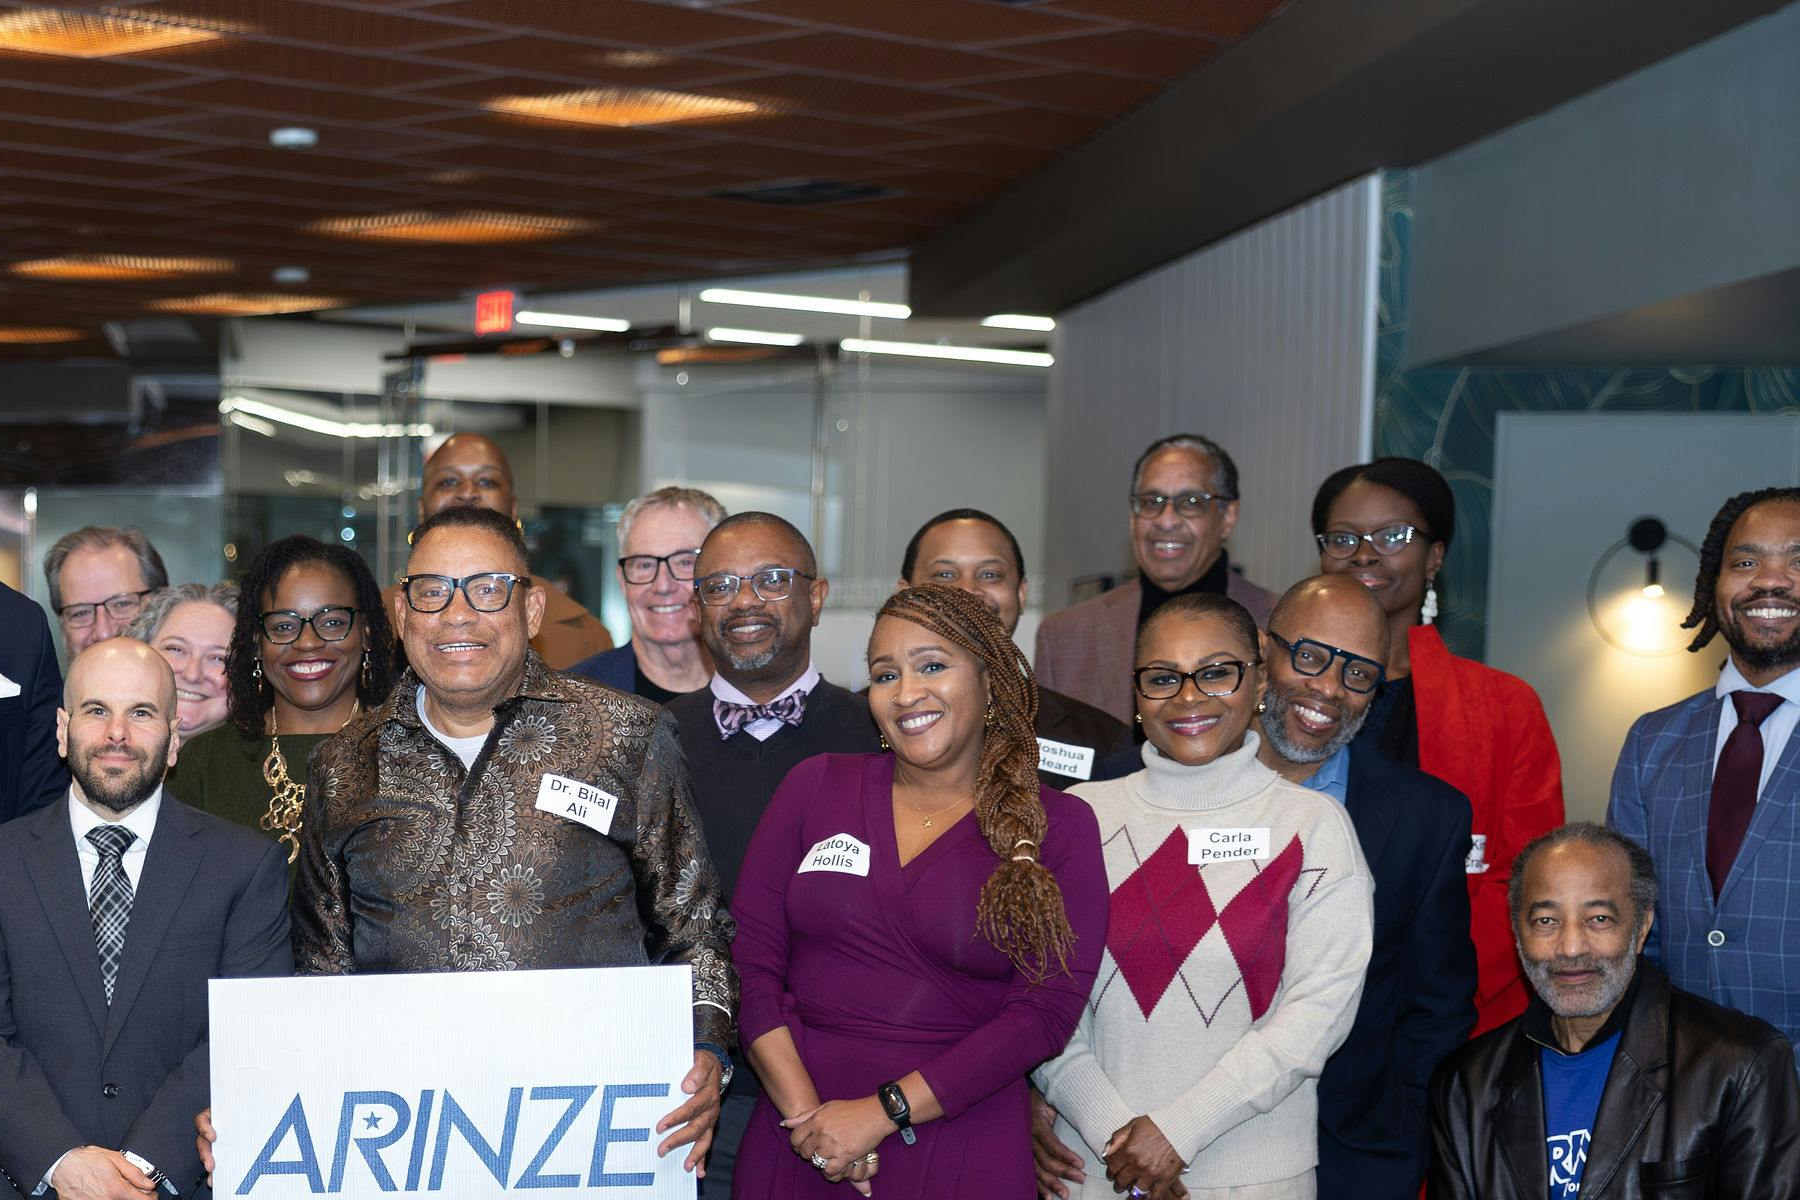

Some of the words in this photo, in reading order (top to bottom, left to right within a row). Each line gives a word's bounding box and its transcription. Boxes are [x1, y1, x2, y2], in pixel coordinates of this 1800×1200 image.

[550, 779, 572, 795] Dr.
[578, 787, 611, 810] Bilal
[566, 802, 588, 818] Ali
[1209, 832, 1252, 844] Carla
[1201, 847, 1260, 859] Pender
[812, 854, 854, 868] Hollis
[234, 1083, 670, 1195] ARINZE
